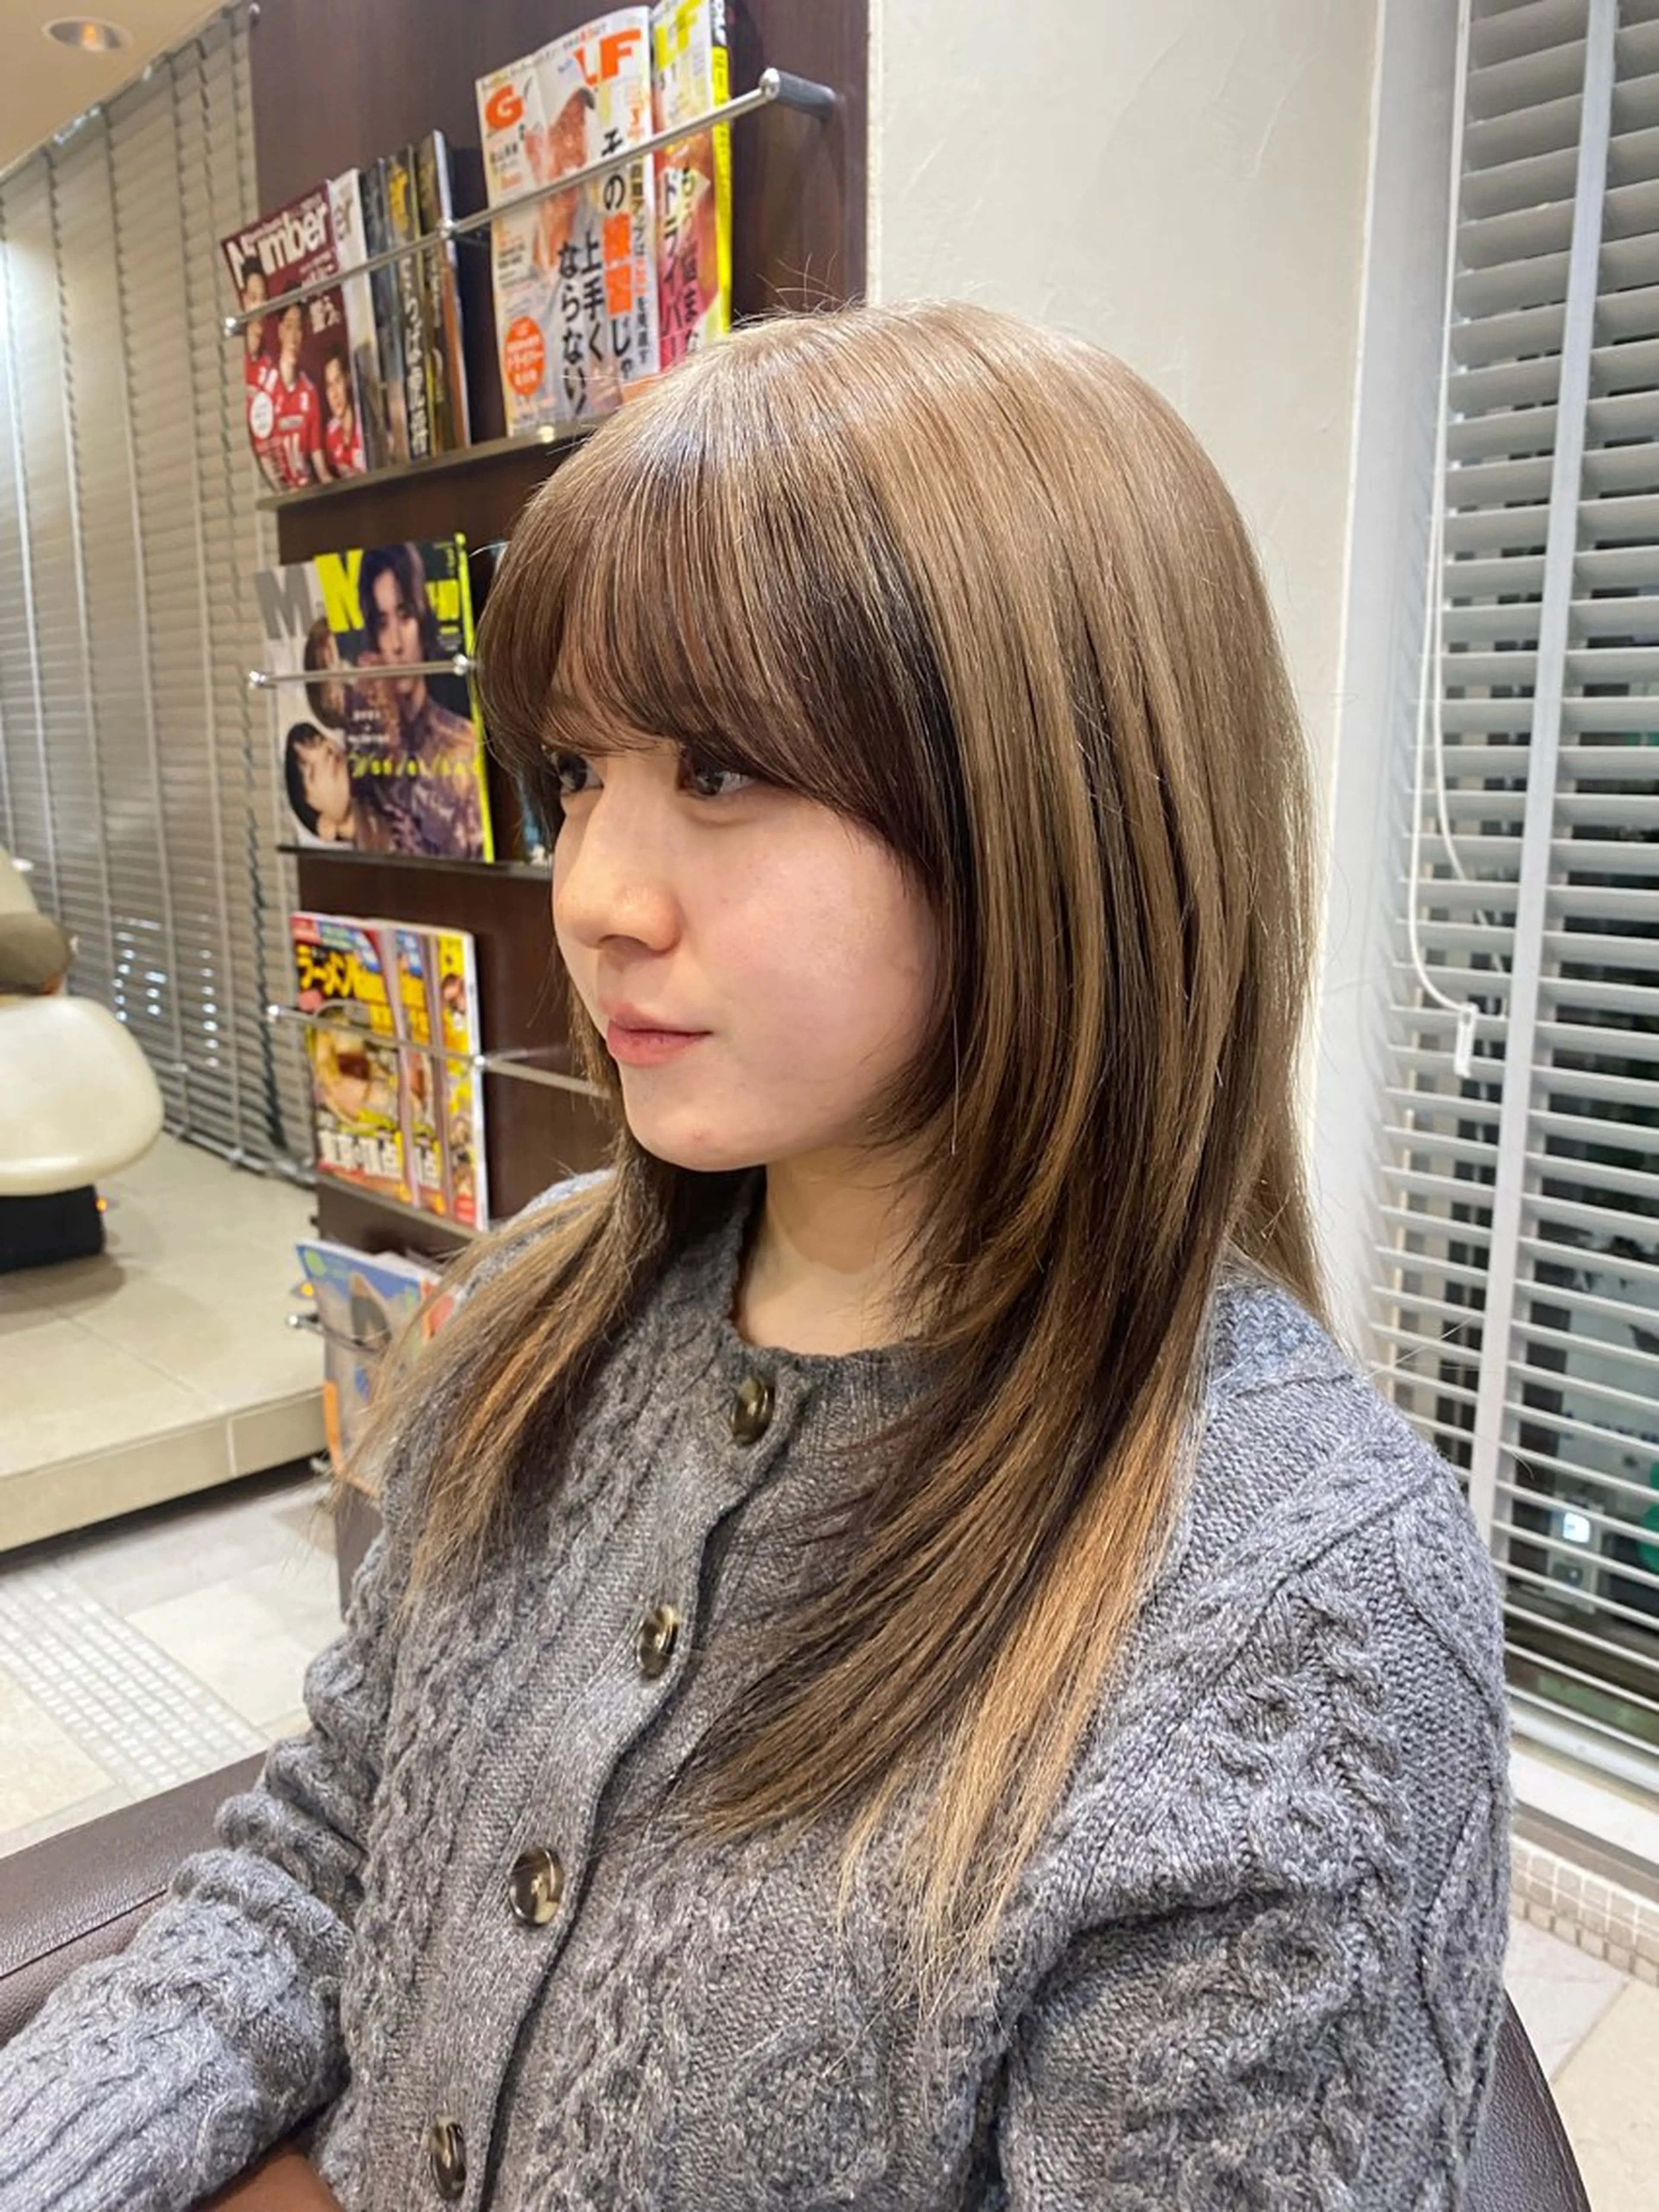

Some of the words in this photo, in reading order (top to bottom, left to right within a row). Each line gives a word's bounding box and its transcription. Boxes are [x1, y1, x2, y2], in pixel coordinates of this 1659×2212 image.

[485, 28, 642, 130] GLF
[582, 229, 604, 363] 上手く
